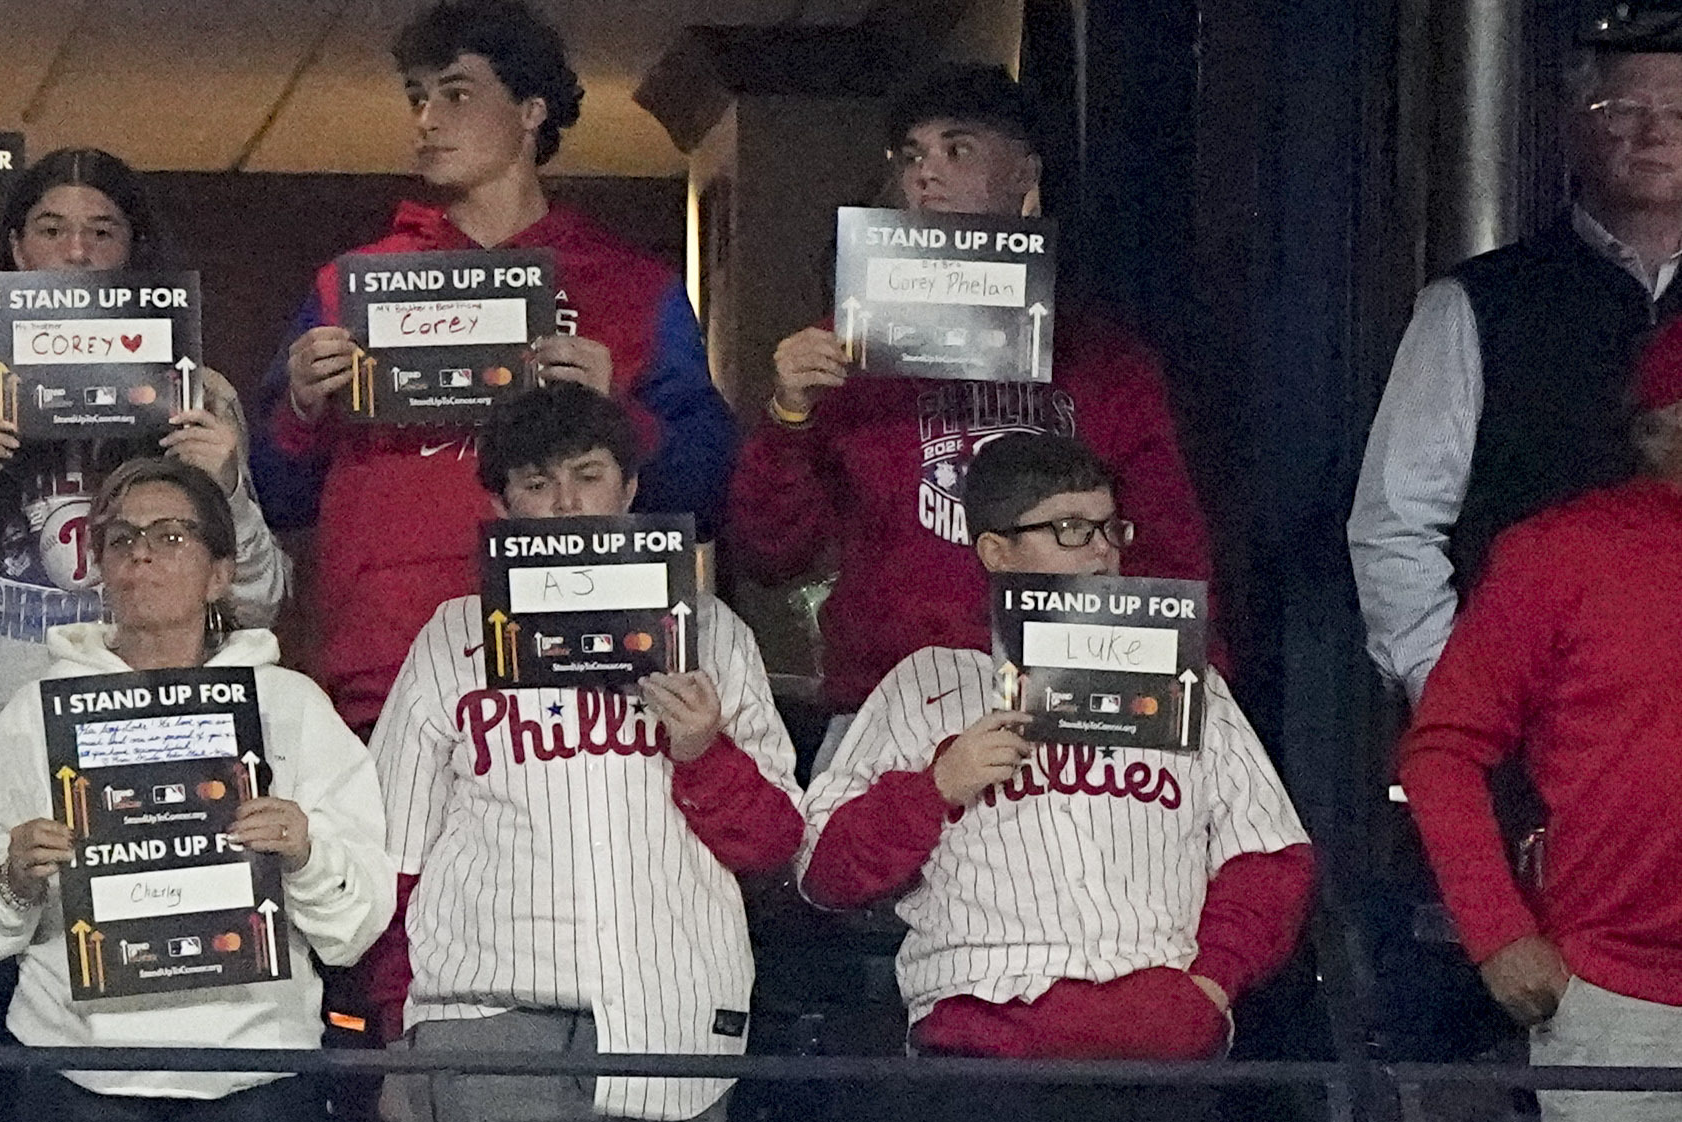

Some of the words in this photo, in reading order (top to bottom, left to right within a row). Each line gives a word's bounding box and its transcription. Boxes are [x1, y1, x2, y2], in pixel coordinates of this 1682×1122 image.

[866, 227, 947, 249] STAND
[954, 231, 988, 251] UP
[995, 232, 1045, 254] FOR
[349, 273, 356, 293] I
[364, 270, 445, 292] STAND
[452, 269, 486, 289] UP
[494, 267, 543, 288] FOR
[9, 289, 91, 309] STAND
[99, 288, 132, 308] UP
[139, 288, 188, 308] FOR
[31, 332, 114, 357] COREY
[489, 538, 497, 557] I
[504, 535, 584, 557] STAND
[592, 533, 626, 554] UP
[634, 531, 683, 552] FOR
[1005, 590, 1012, 610] I
[1020, 591, 1101, 614] STAND
[1109, 595, 1141, 615] UP
[1148, 597, 1196, 619] FOR
[54, 696, 62, 716] I
[70, 688, 152, 714] STAND
[159, 684, 192, 706] UP
[199, 683, 247, 704] FOR
[456, 687, 670, 776] Philli
[931, 734, 1182, 824] illies
[85, 839, 167, 867] STAND
[174, 835, 208, 857] UP
